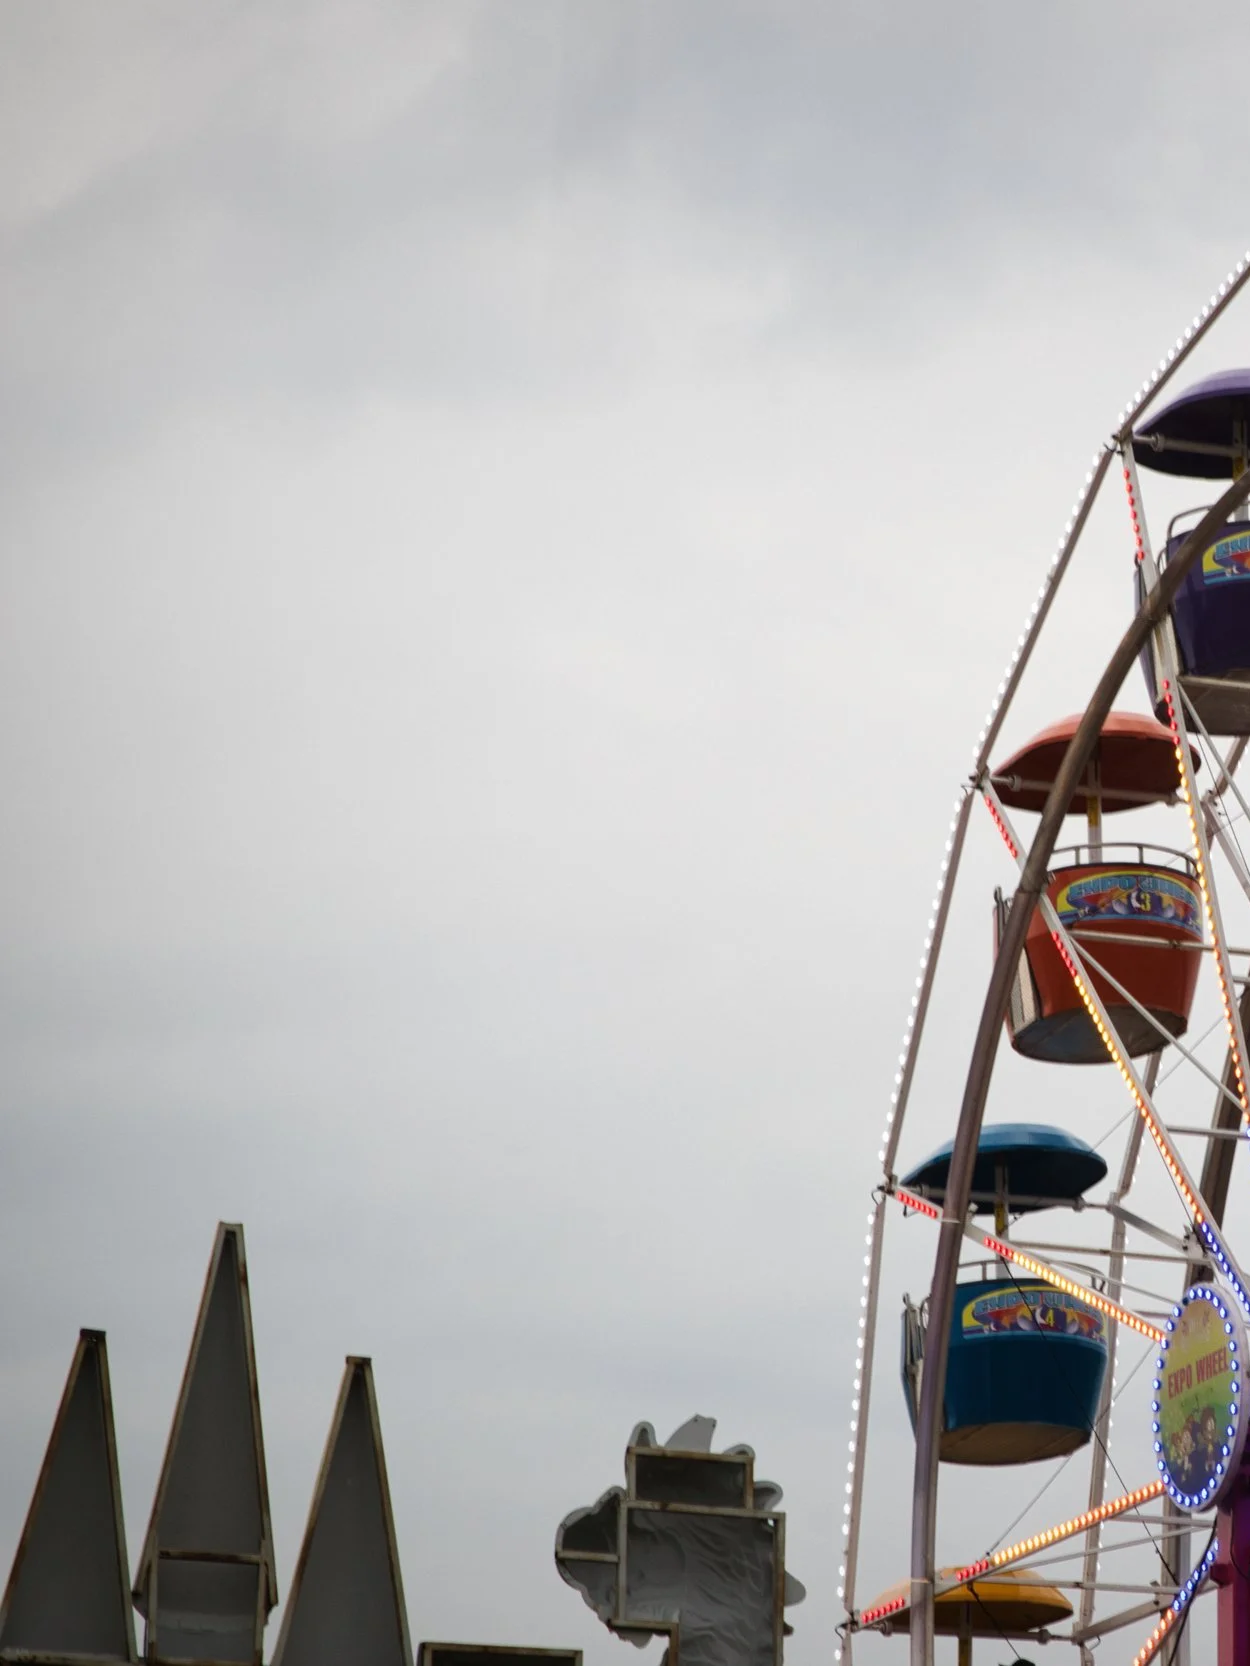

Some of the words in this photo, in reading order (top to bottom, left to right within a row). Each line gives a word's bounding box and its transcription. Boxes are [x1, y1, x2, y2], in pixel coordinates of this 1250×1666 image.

[1140, 892, 1151, 912] 3
[1045, 1308, 1054, 1327] 4
[1168, 1364, 1193, 1400] EXPO
[1196, 1346, 1229, 1385] WHEEL
